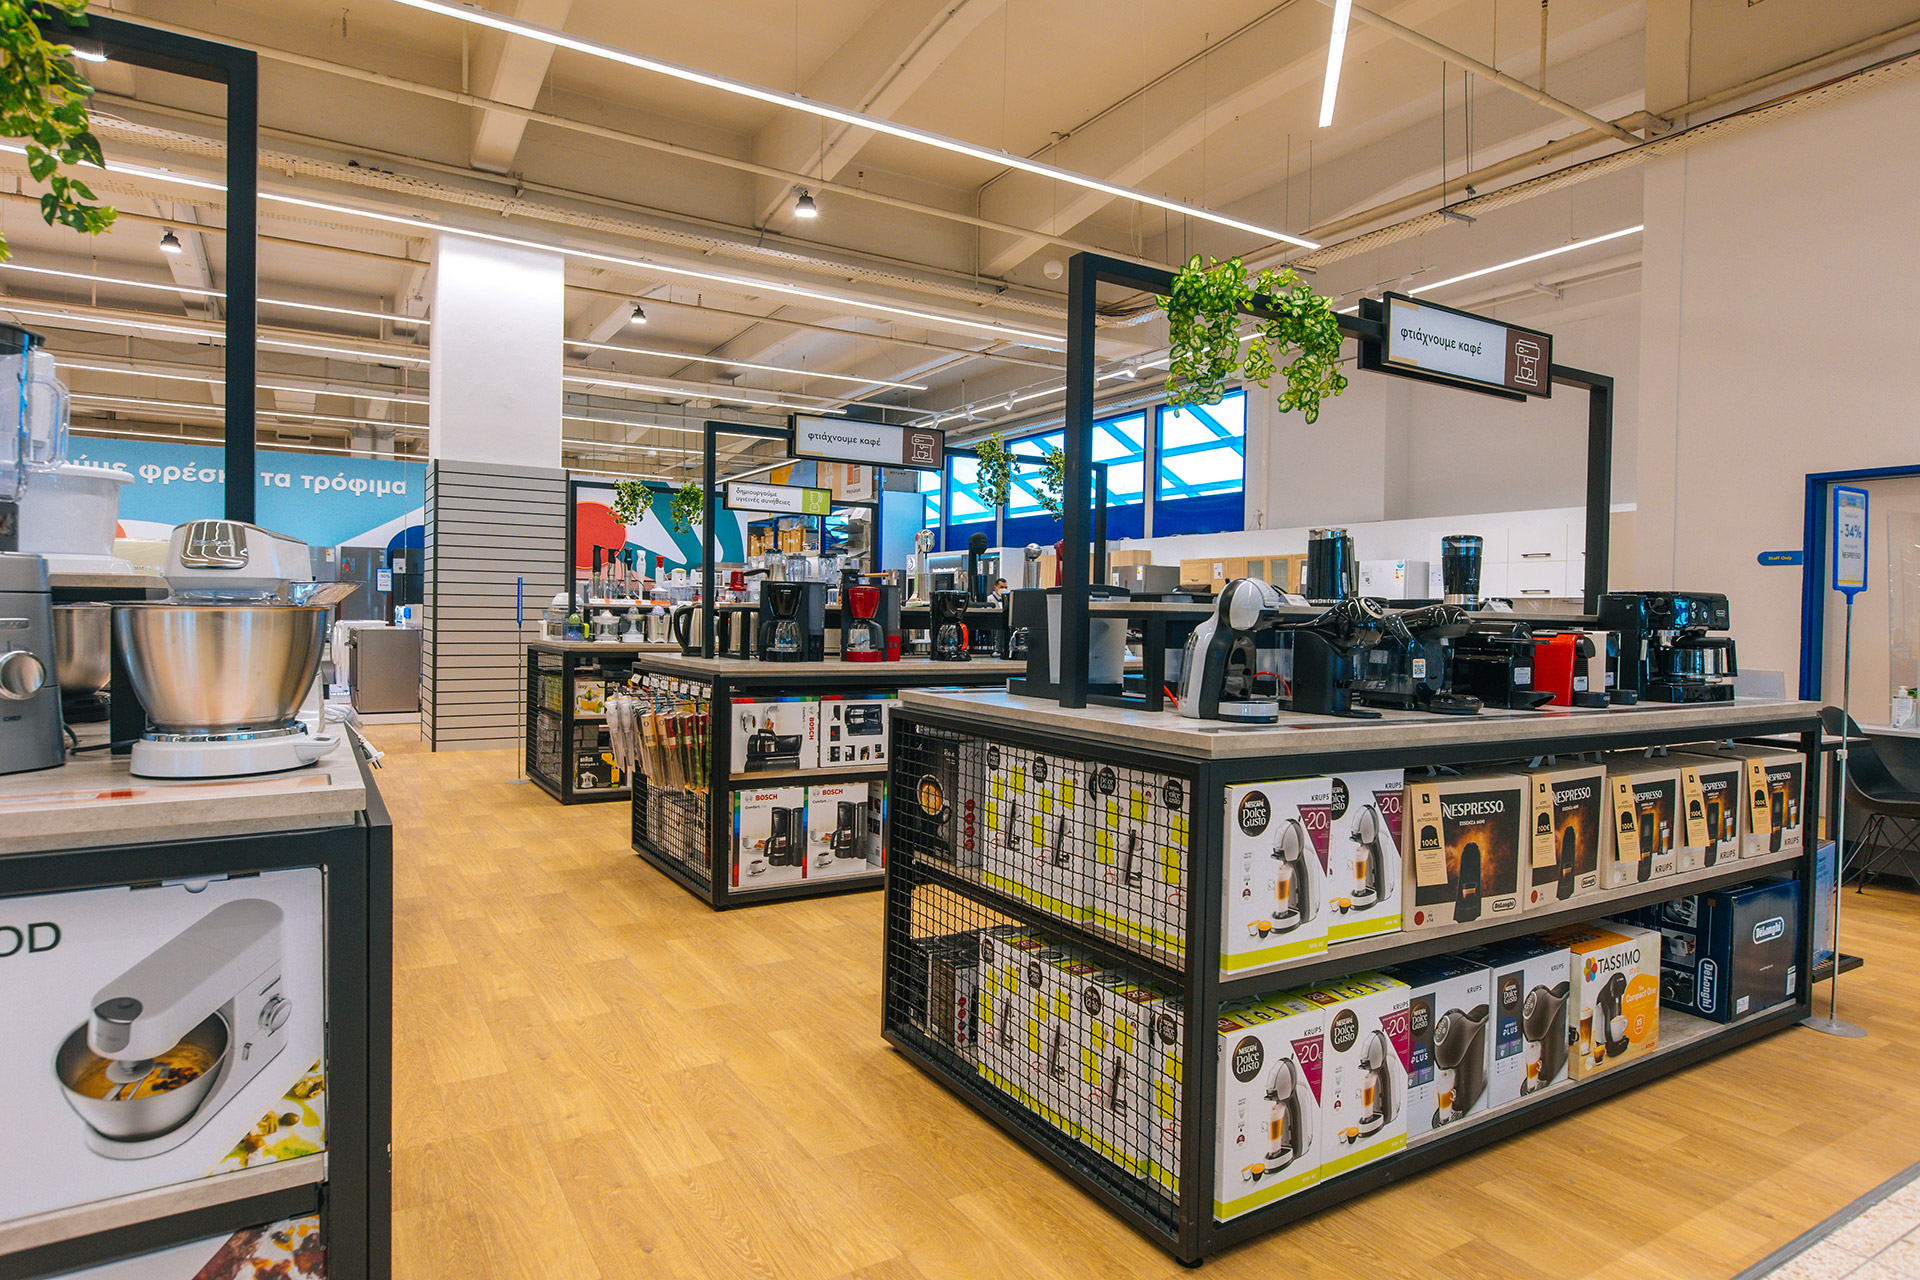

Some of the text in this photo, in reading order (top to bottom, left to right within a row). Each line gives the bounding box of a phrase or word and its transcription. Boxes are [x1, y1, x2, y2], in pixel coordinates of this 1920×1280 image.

[1400, 327, 1482, 358] φτιάχνουμε καφέ
[807, 431, 882, 447] φτιάχνουμε καφέ
[260, 470, 291, 488] τα
[301, 470, 408, 496] τρόφιμα
[1385, 781, 1402, 789] KRUPS
[755, 793, 778, 801] BOSCH
[822, 788, 844, 796] BOSCH
[1551, 786, 1591, 806] NESPRESSO
[1633, 790, 1663, 803] NESPRESSO
[1242, 807, 1267, 819] Dolce
[1440, 800, 1504, 819] NESPRESSO
[1242, 818, 1266, 828] Gusto
[1537, 824, 1551, 832] 100€
[1421, 838, 1438, 847] 100€
[1784, 836, 1800, 845] KRUPS
[1720, 849, 1736, 859] KRUPS
[1655, 862, 1673, 873] KRUPS
[1597, 948, 1641, 974] TASSIMO
[1550, 963, 1565, 972] KRUPS
[1466, 984, 1482, 994] KRUPS
[1626, 987, 1657, 1003] Compact One
[1393, 1001, 1409, 1011] KRUPS
[1303, 1026, 1322, 1036] KRUPS
[1334, 1024, 1355, 1037] Dolce
[1502, 1026, 1518, 1036] PLUS
[1334, 1032, 1355, 1045] Gusto
[1236, 1052, 1260, 1066] Dolce
[1411, 1054, 1429, 1064] PLUS
[1236, 1061, 1260, 1075] Gusto
